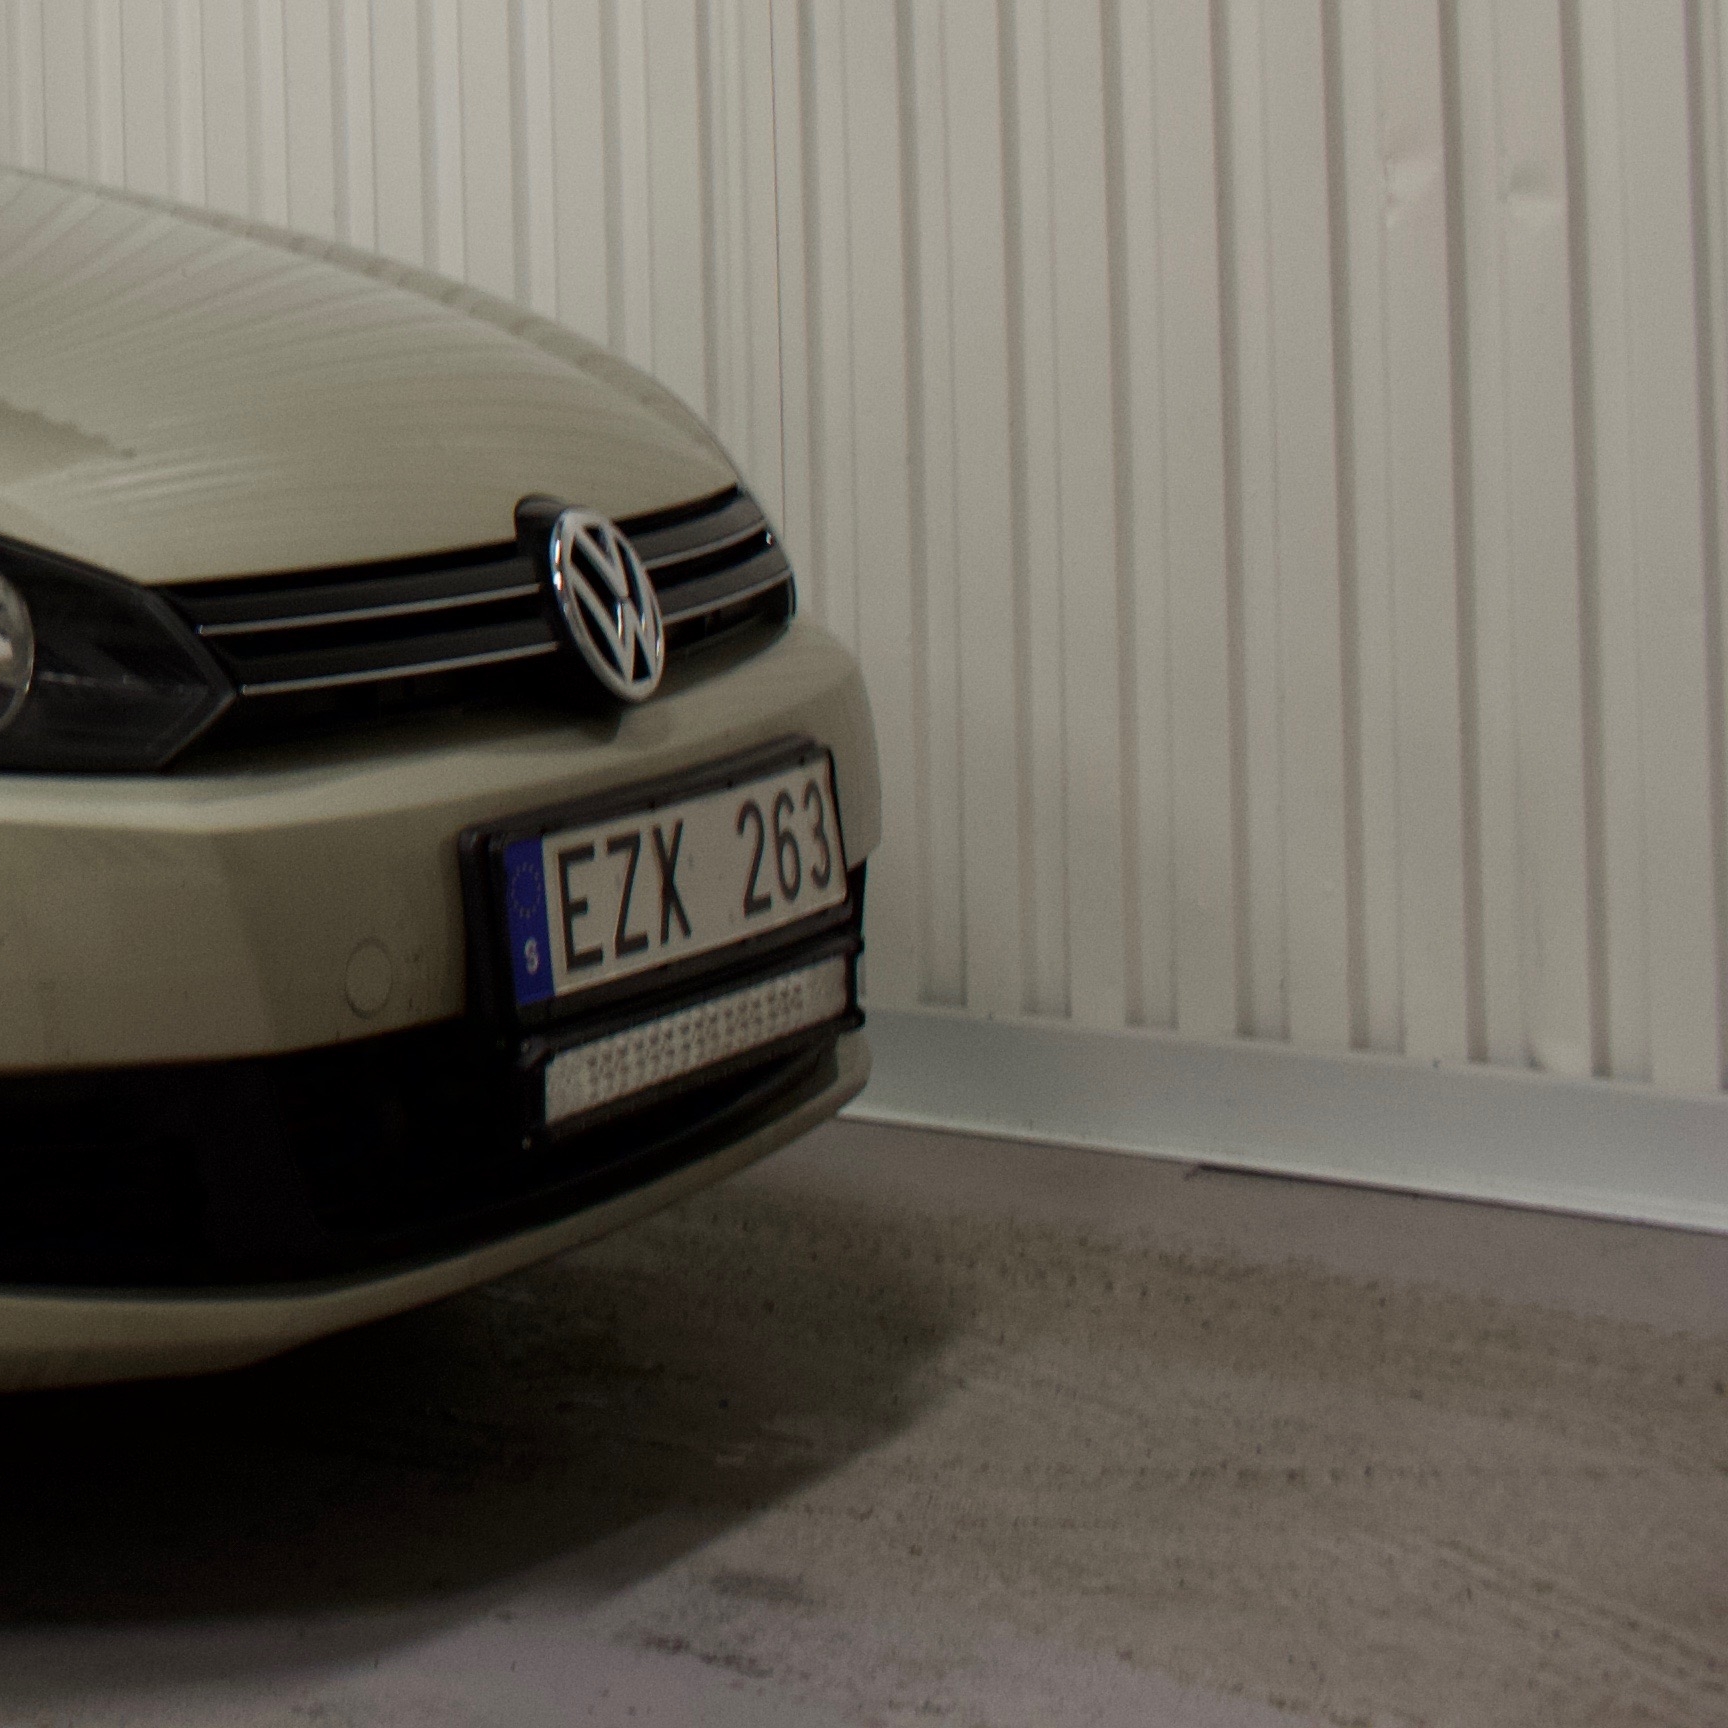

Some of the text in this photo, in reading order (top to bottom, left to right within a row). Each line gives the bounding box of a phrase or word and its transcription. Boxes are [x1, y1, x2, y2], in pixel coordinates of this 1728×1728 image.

[523, 778, 833, 974] S EZX 263
